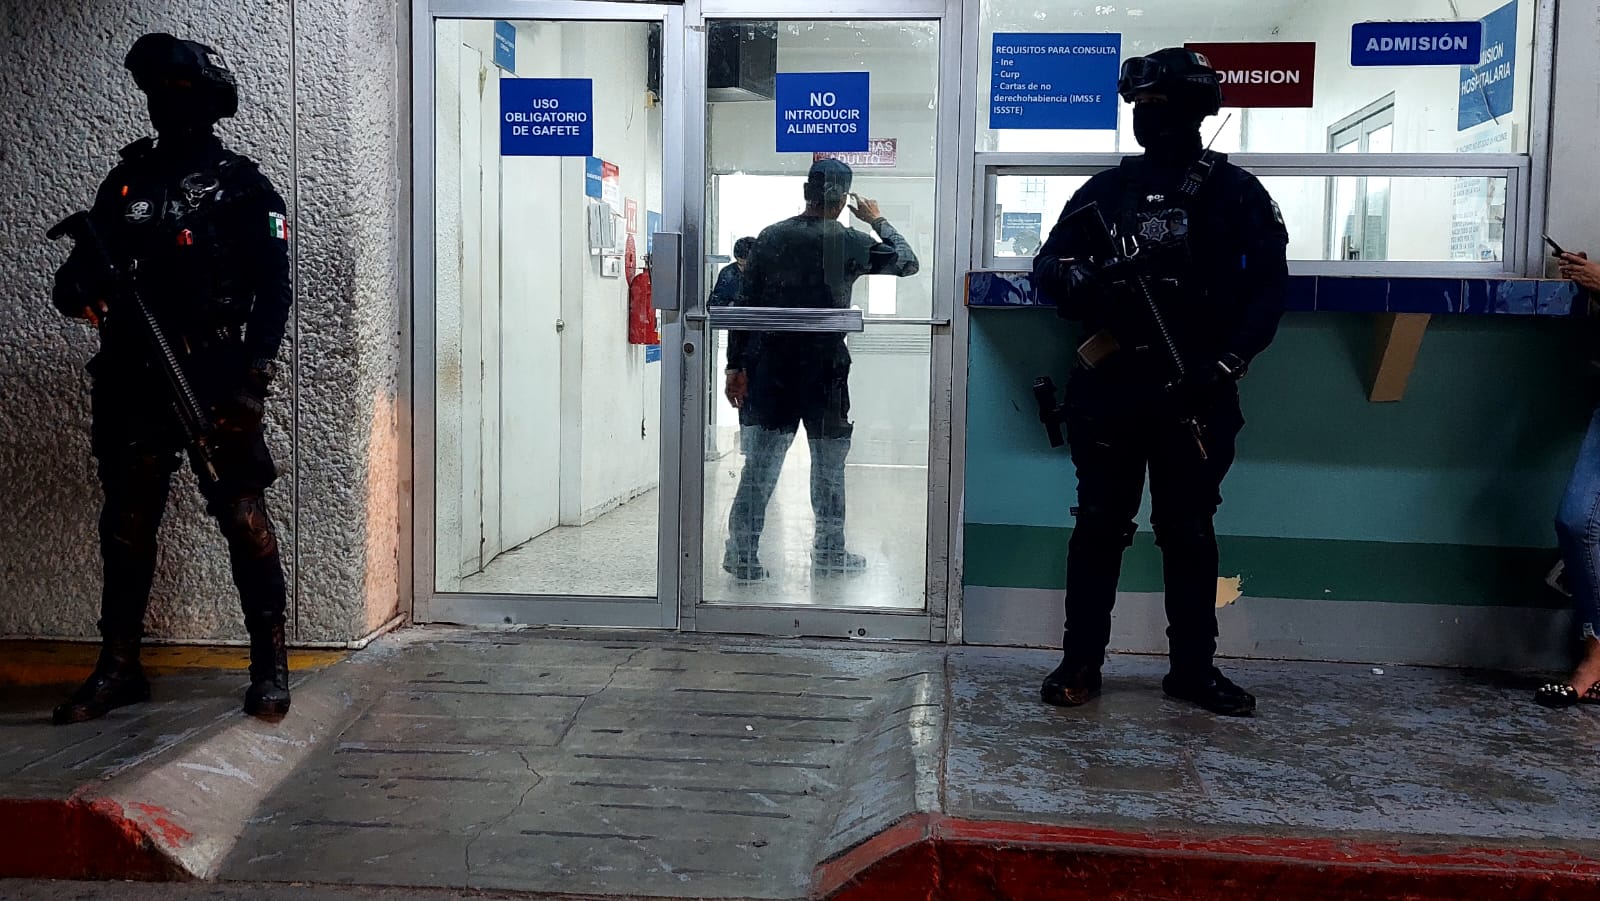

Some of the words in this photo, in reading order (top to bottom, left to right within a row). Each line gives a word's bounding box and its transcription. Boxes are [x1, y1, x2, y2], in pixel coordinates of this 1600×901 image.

[1365, 33, 1468, 51] ADMISIÓN
[996, 46, 1046, 55] REQUISITOS
[1047, 46, 1071, 54] PARA
[1072, 46, 1117, 55] CONSULTA
[1000, 58, 1014, 66] Ine
[1000, 70, 1020, 80] Curp
[1216, 70, 1300, 84] DMISION
[999, 82, 1026, 90] Cartas
[1027, 82, 1038, 90] de
[1040, 83, 1052, 91] no
[533, 98, 559, 109] USO
[810, 92, 836, 107] NO
[993, 93, 1068, 103] derechohabiencia
[1069, 94, 1094, 104] (IMSS
[1095, 94, 1101, 103] E
[785, 109, 860, 120] INTRODUCIR
[993, 106, 1023, 115] ISSSTE)
[505, 112, 587, 122] OBLIGATORIO
[512, 125, 529, 136] DE
[532, 125, 580, 136] GAFETE
[787, 123, 857, 134] ALIMENTOS
